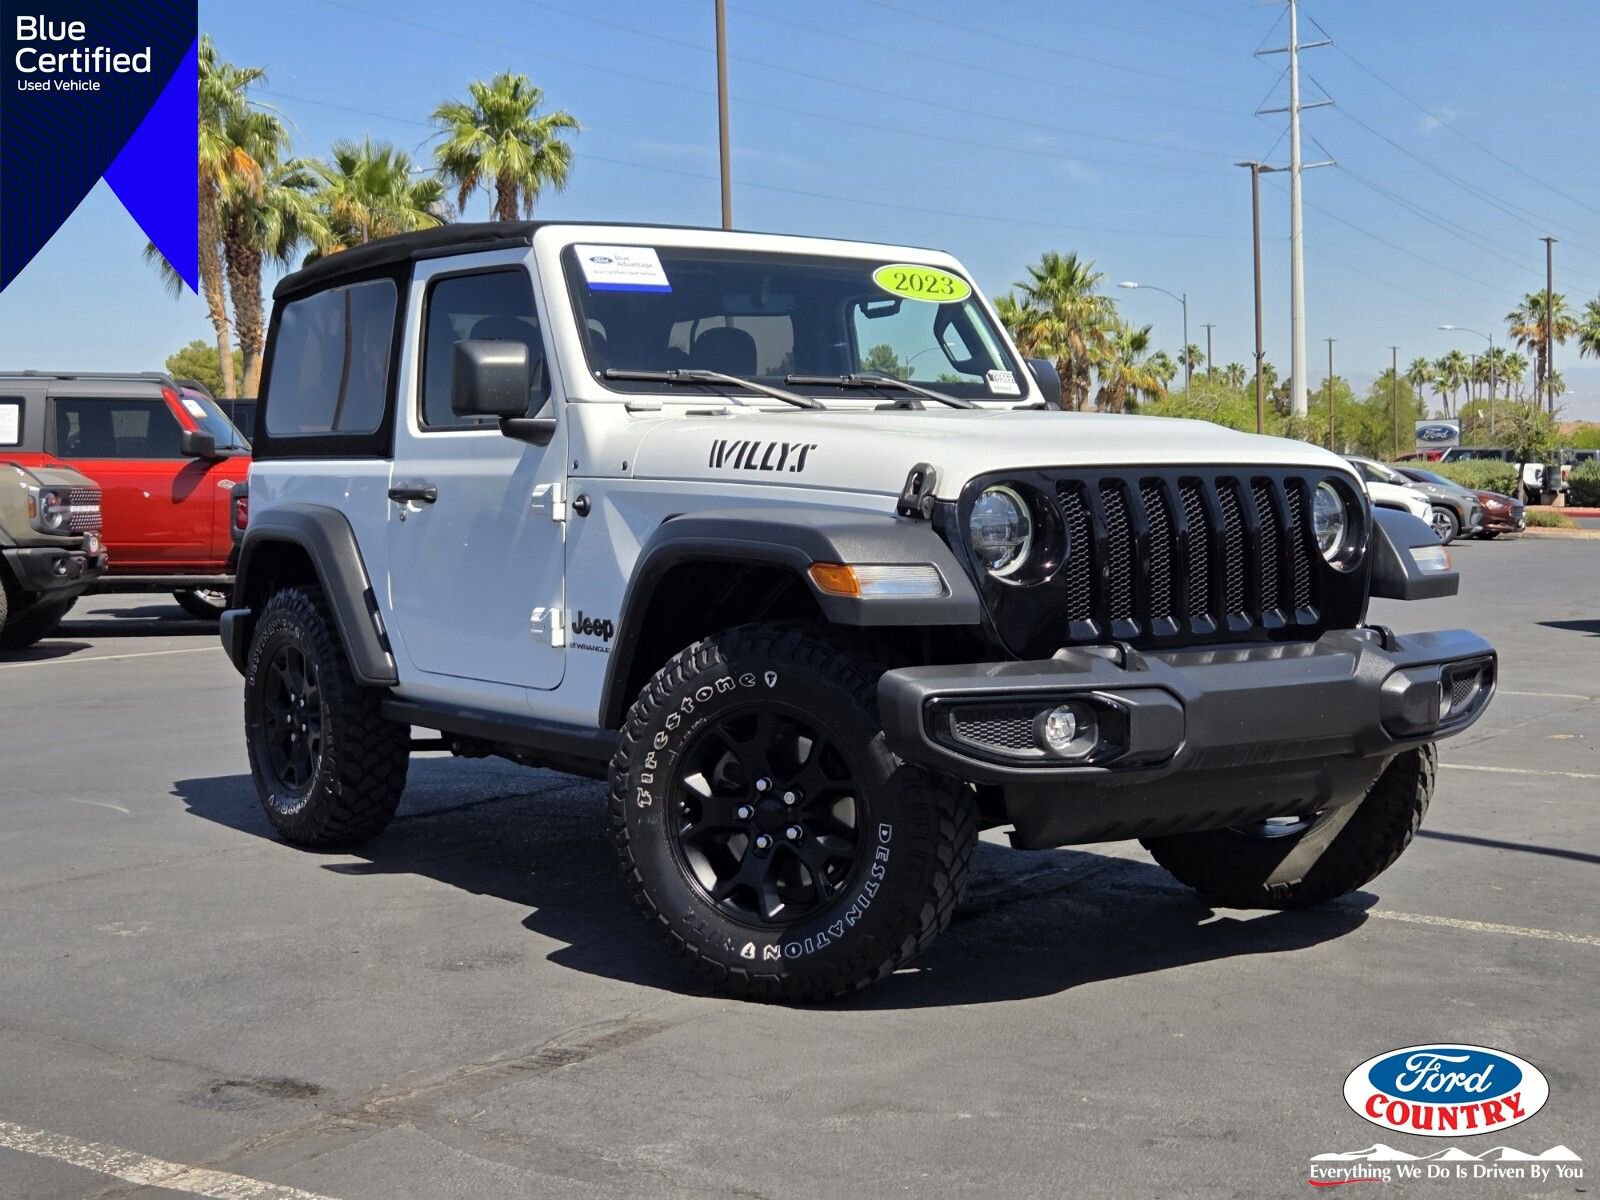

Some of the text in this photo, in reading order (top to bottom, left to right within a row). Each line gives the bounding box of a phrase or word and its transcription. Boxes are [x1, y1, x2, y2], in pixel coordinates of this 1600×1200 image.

[894, 272, 954, 295] 2023
[1421, 426, 1449, 440] Ford
[709, 439, 818, 473] WILLYS
[571, 610, 614, 642] Jeep
[637, 673, 756, 808] Firestone
[763, 823, 893, 961] DESTINATION
